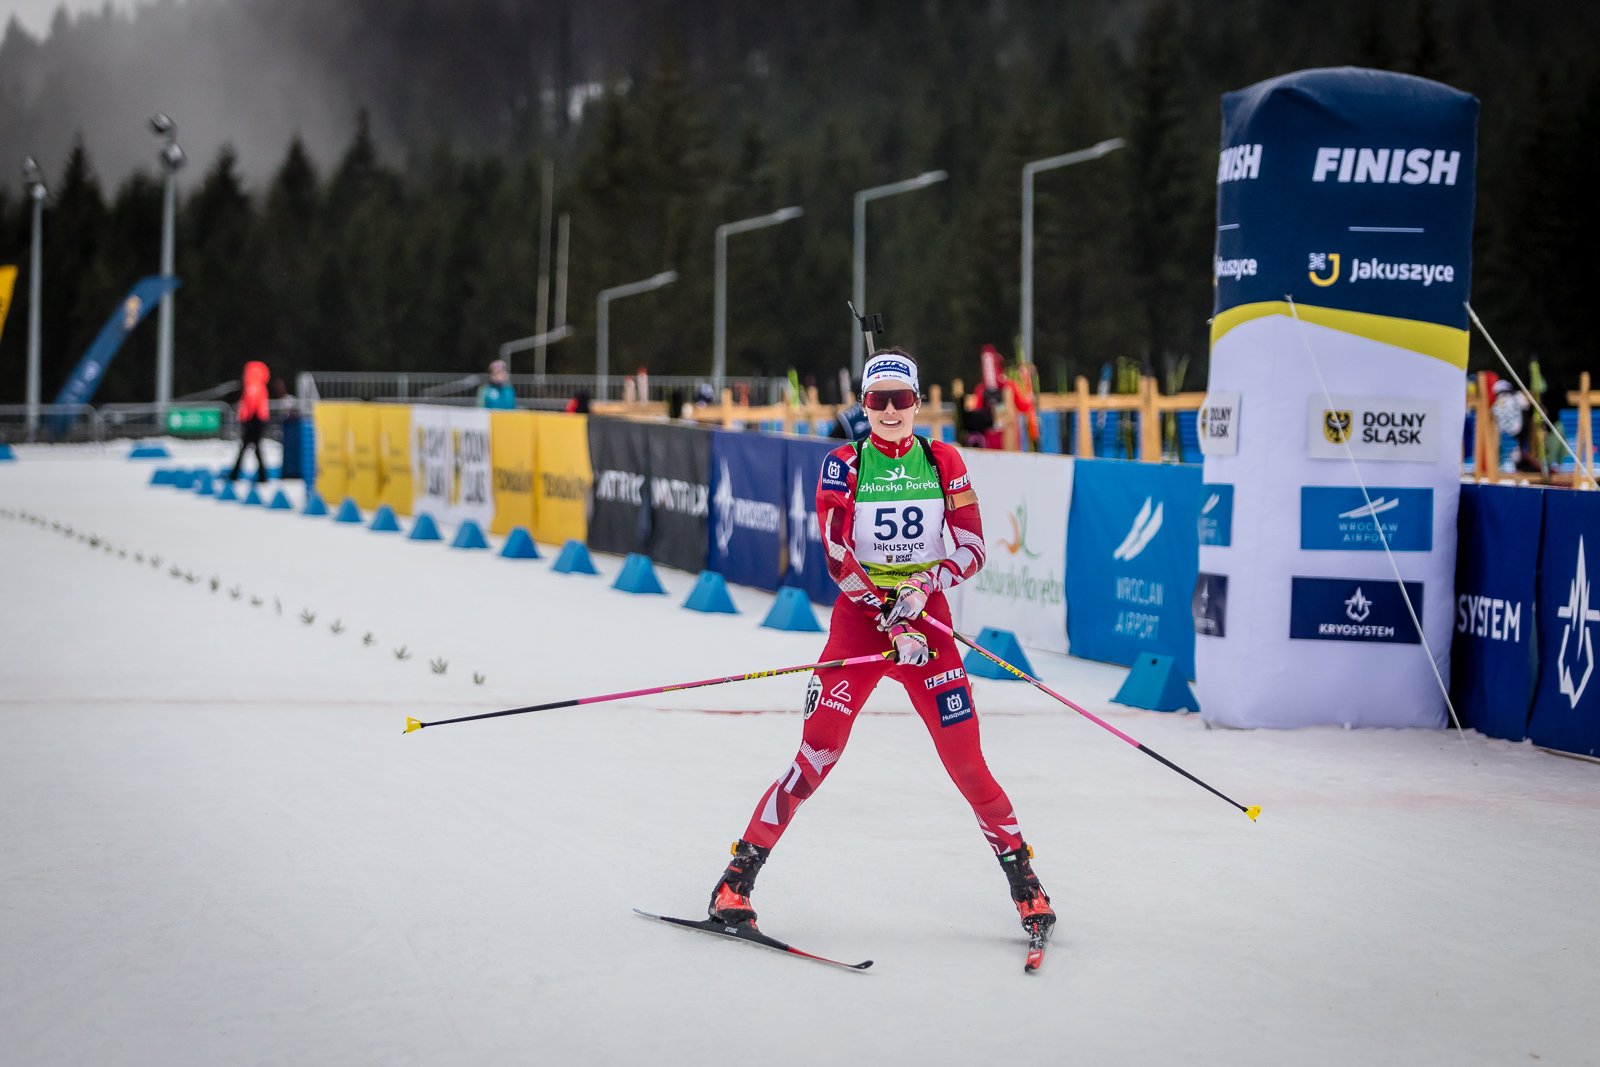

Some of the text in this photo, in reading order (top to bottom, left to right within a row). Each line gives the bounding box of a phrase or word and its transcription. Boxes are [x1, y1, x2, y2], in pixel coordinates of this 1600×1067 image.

[1312, 147, 1460, 185] FINISH
[1349, 257, 1454, 286] Jakuszyce
[1362, 411, 1426, 428] DOLNY
[1362, 426, 1421, 446] ŚLĄSK
[822, 478, 848, 487] Husqvarna
[859, 480, 939, 494] zklarska Poręba
[874, 506, 924, 541] 58
[873, 542, 924, 553] Jakuszyce
[1457, 593, 1521, 643] SYSTEM
[1318, 623, 1395, 638] KRYOSYSTEM
[926, 668, 965, 689] HELLA
[1000, 660, 1024, 679] LEKI
[942, 708, 971, 722] Husqvarna
